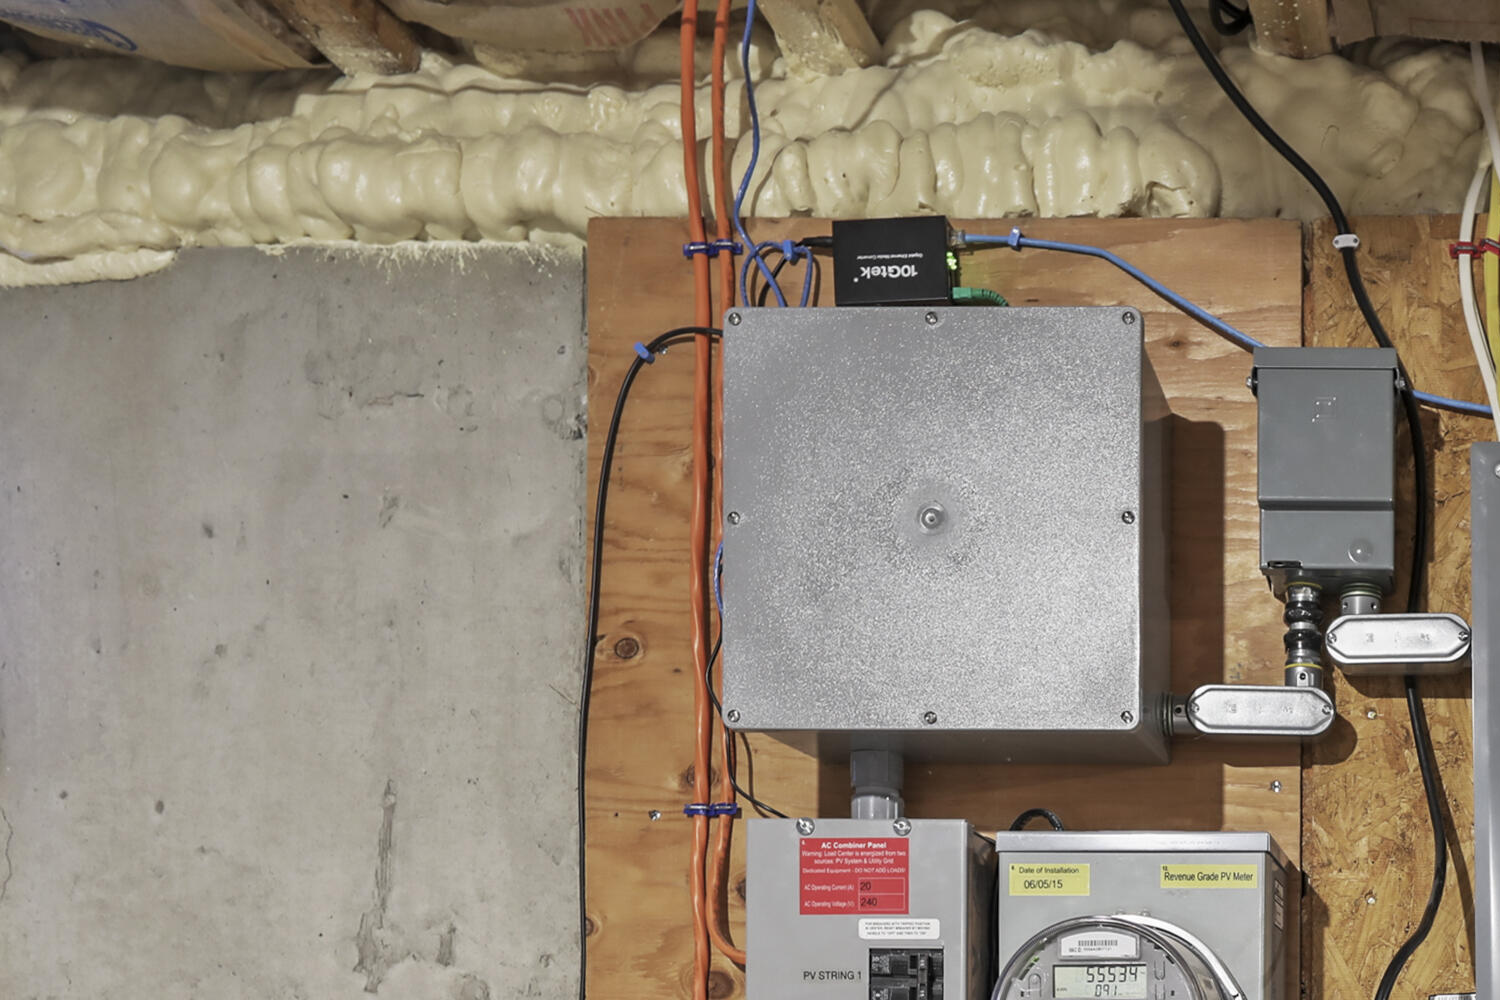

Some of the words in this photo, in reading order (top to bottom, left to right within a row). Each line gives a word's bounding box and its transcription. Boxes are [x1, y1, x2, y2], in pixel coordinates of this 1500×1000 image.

[860, 264, 918, 279] 10Gtek
[1018, 866, 1034, 874] Date
[1035, 866, 1043, 874] of
[1043, 866, 1080, 874] Installation
[1164, 872, 1196, 882] Revenue
[1196, 872, 1219, 882] Grade
[1220, 872, 1233, 881] PV
[1234, 872, 1253, 882] Meter
[860, 881, 872, 891] 20
[1023, 879, 1064, 889] 06/05/15
[860, 897, 878, 907] 240
[803, 971, 817, 980] PV
[818, 970, 855, 981] STRING
[857, 971, 862, 980] 1
[1086, 965, 1138, 983] 55534
[1094, 984, 1118, 998] 091
